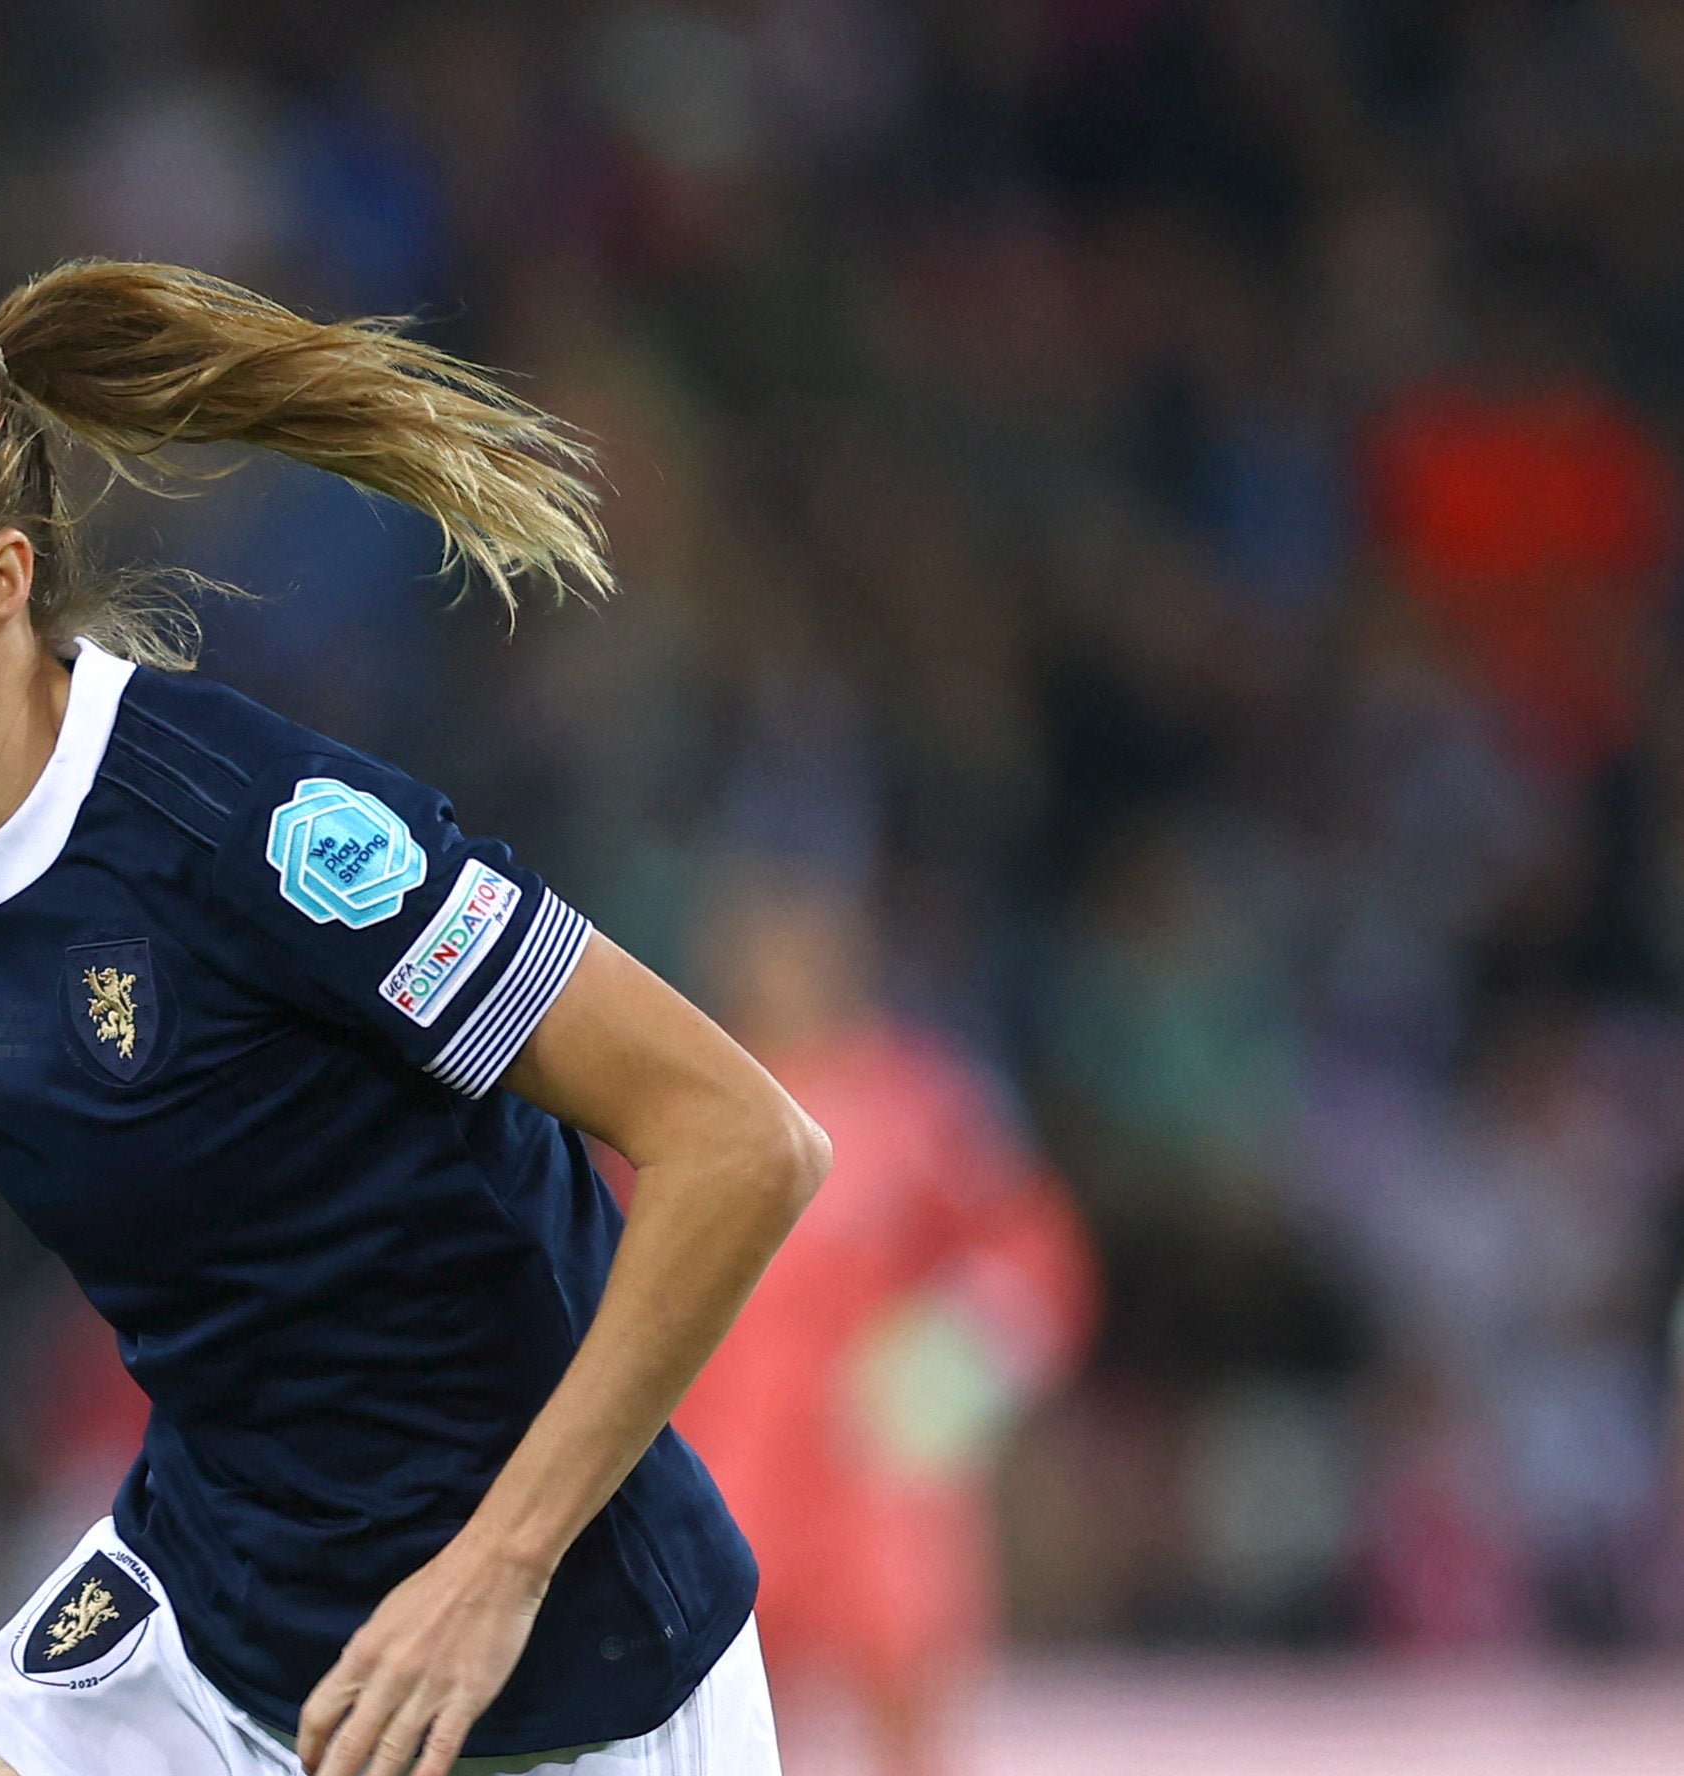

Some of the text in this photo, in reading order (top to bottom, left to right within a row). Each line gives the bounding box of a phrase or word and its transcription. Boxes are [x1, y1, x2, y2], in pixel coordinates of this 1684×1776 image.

[309, 836, 336, 859] We
[324, 837, 361, 873] Play
[338, 833, 389, 884] Strong
[396, 870, 503, 1013] FOUNDATION
[384, 962, 417, 998] UEFA
